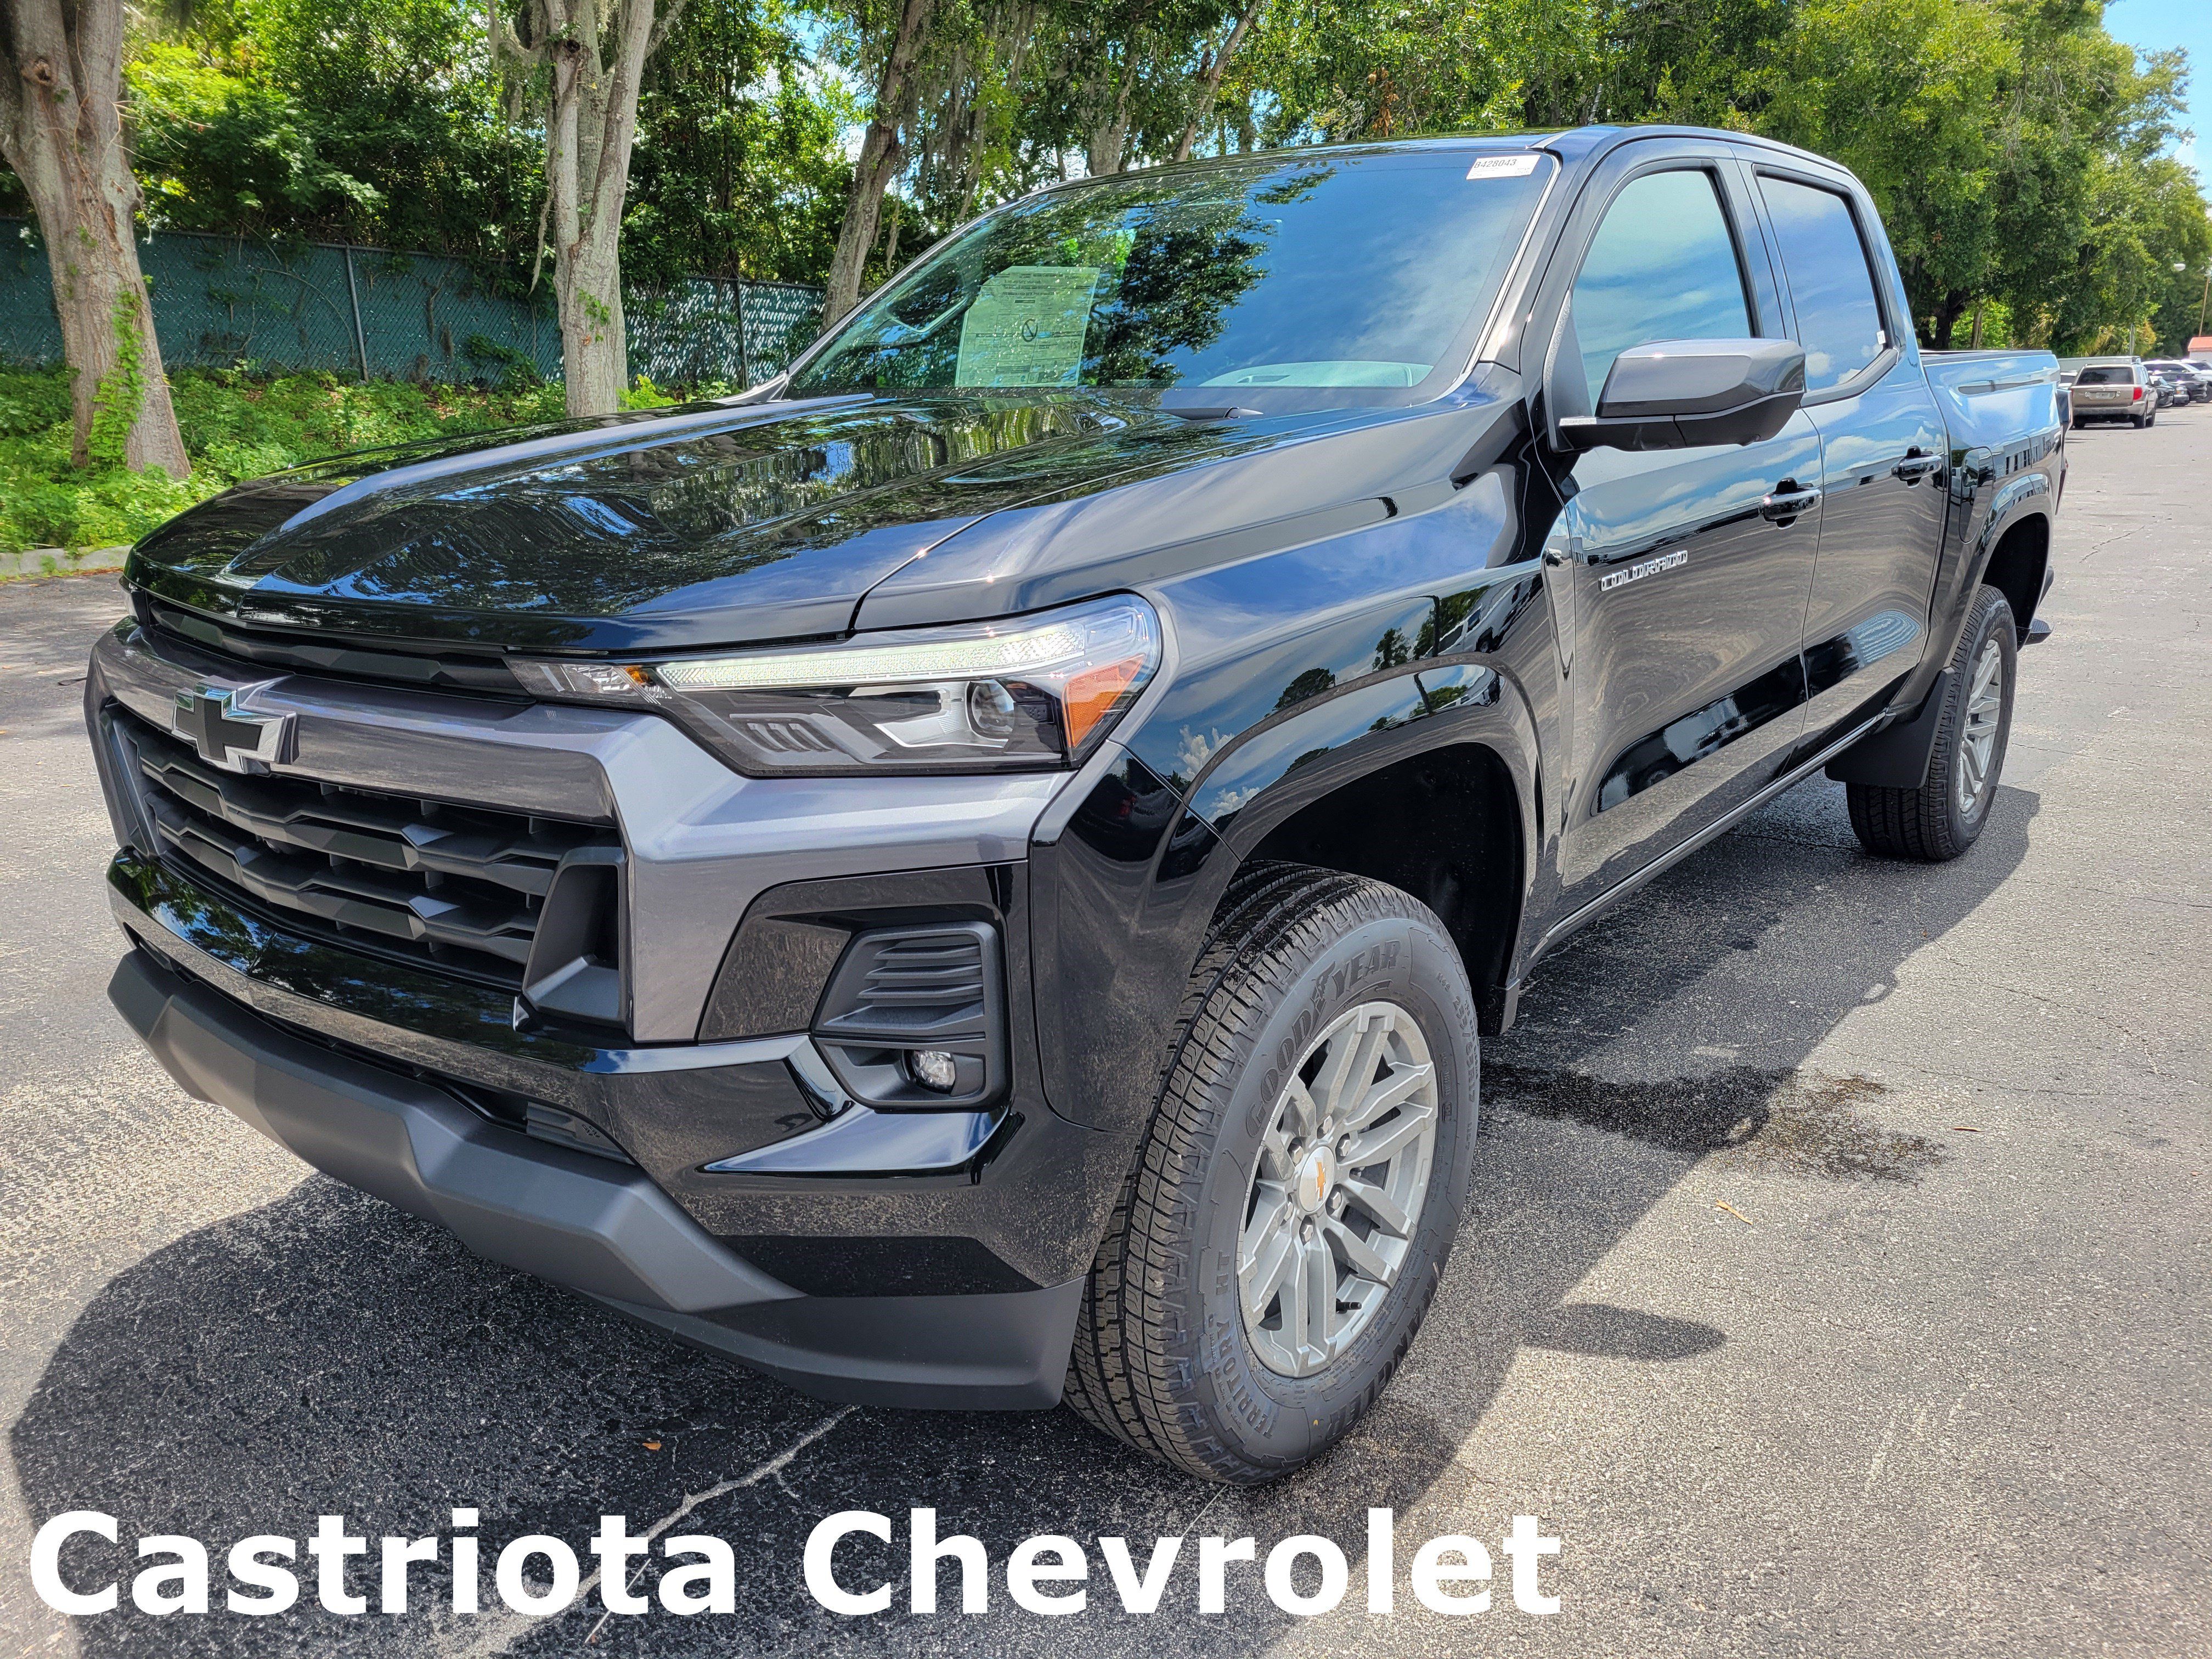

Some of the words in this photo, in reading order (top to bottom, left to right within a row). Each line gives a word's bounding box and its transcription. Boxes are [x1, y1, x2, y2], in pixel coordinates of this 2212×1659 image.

[1599, 550, 1688, 591] COLORADO
[1245, 939, 1401, 1138] GOODYEAR
[1216, 1250, 1230, 1295] HT
[1216, 1320, 1274, 1438] TERRITORY
